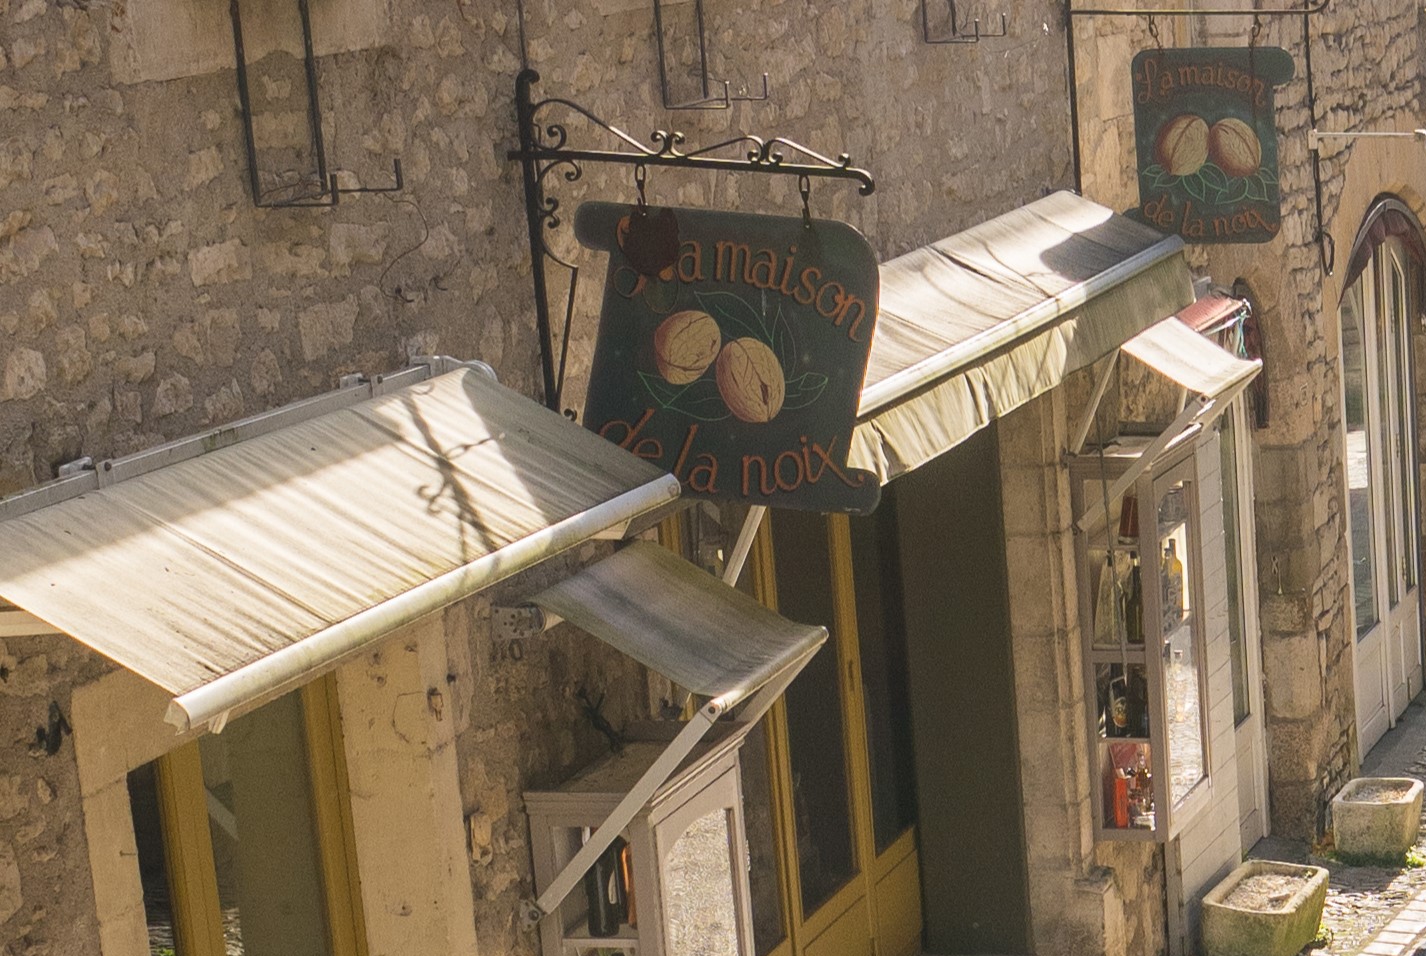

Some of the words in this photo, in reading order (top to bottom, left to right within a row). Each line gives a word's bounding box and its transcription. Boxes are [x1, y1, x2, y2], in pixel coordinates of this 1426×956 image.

[1136, 58, 1173, 103] La
[1177, 61, 1267, 108] maison
[1144, 195, 1174, 229] de
[1182, 201, 1204, 237] la
[713, 239, 867, 342] maison
[599, 408, 663, 459] de
[673, 424, 719, 494] la
[741, 436, 866, 496] noix
